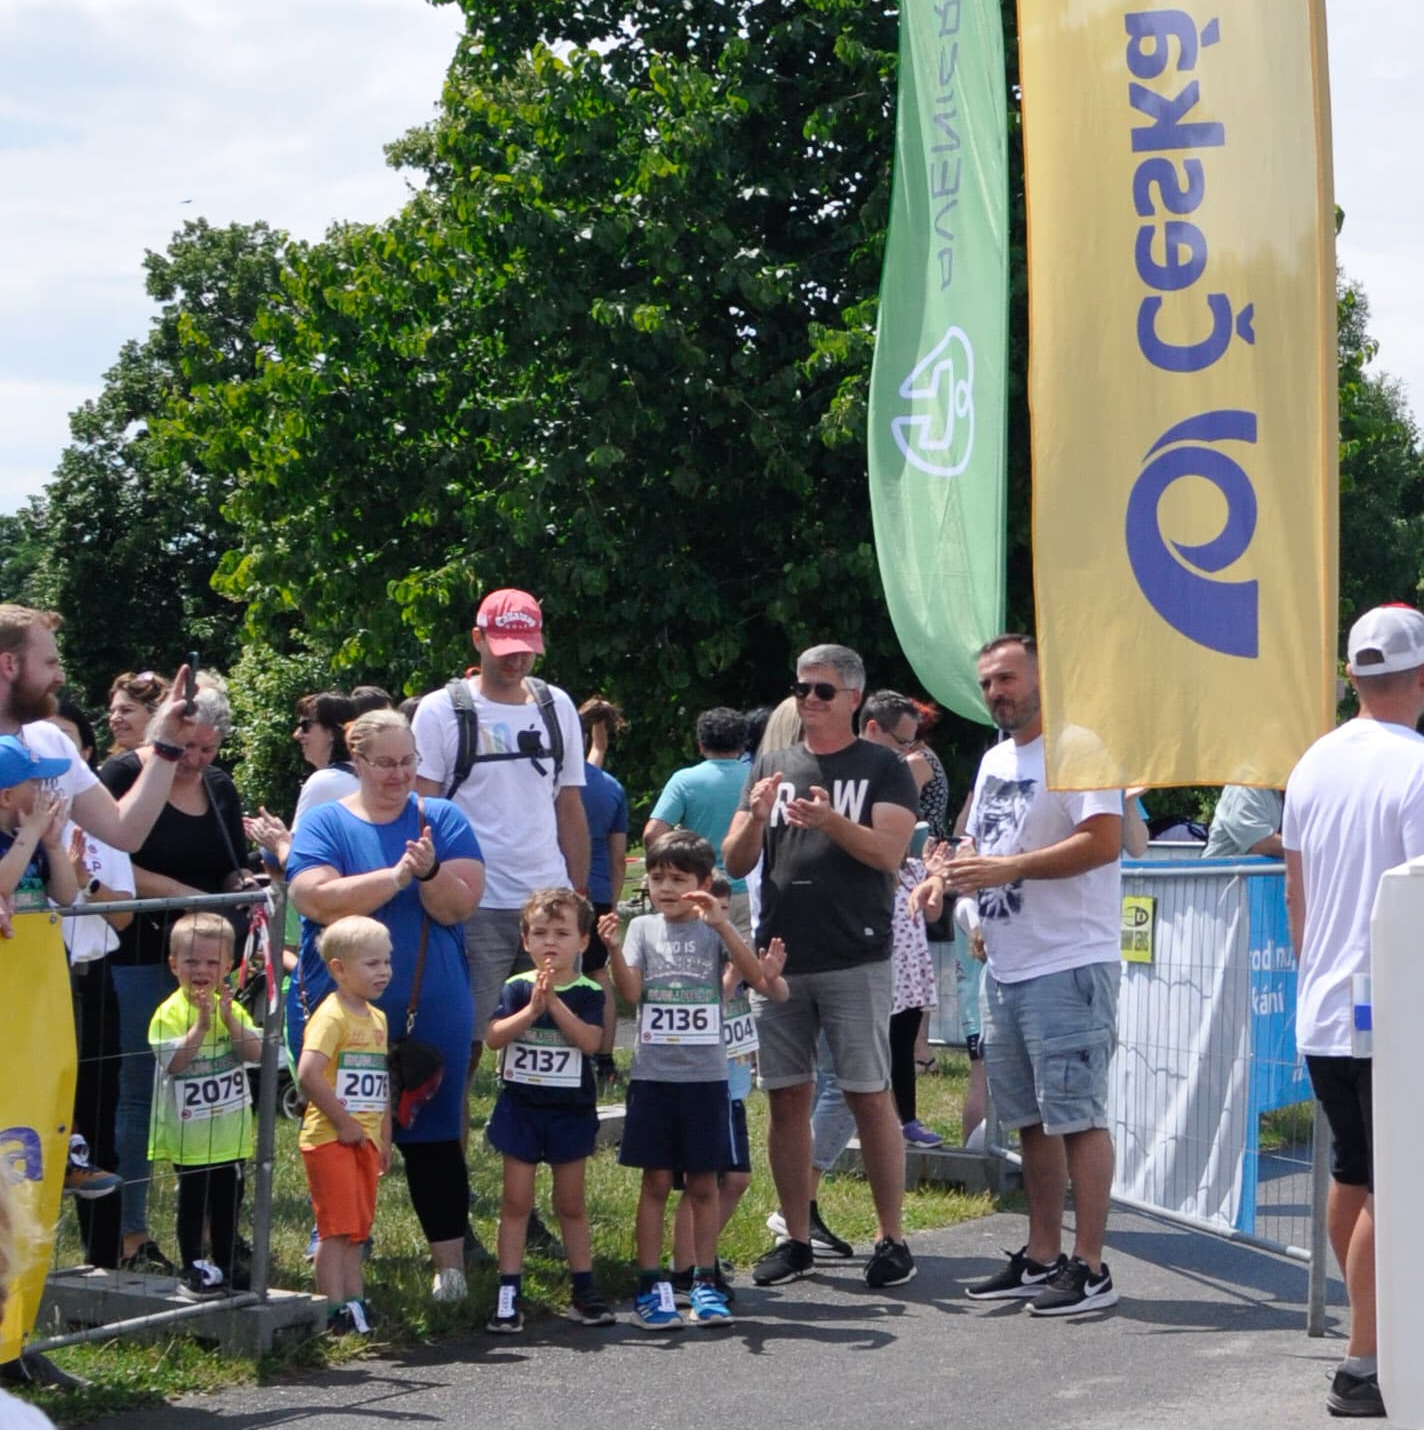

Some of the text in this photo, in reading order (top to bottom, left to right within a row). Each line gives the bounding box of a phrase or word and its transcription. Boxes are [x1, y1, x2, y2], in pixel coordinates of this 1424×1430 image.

[770, 779, 869, 827] RW
[650, 1008, 708, 1030] 2136
[514, 1046, 571, 1073] 2137
[184, 1071, 244, 1106] 2079
